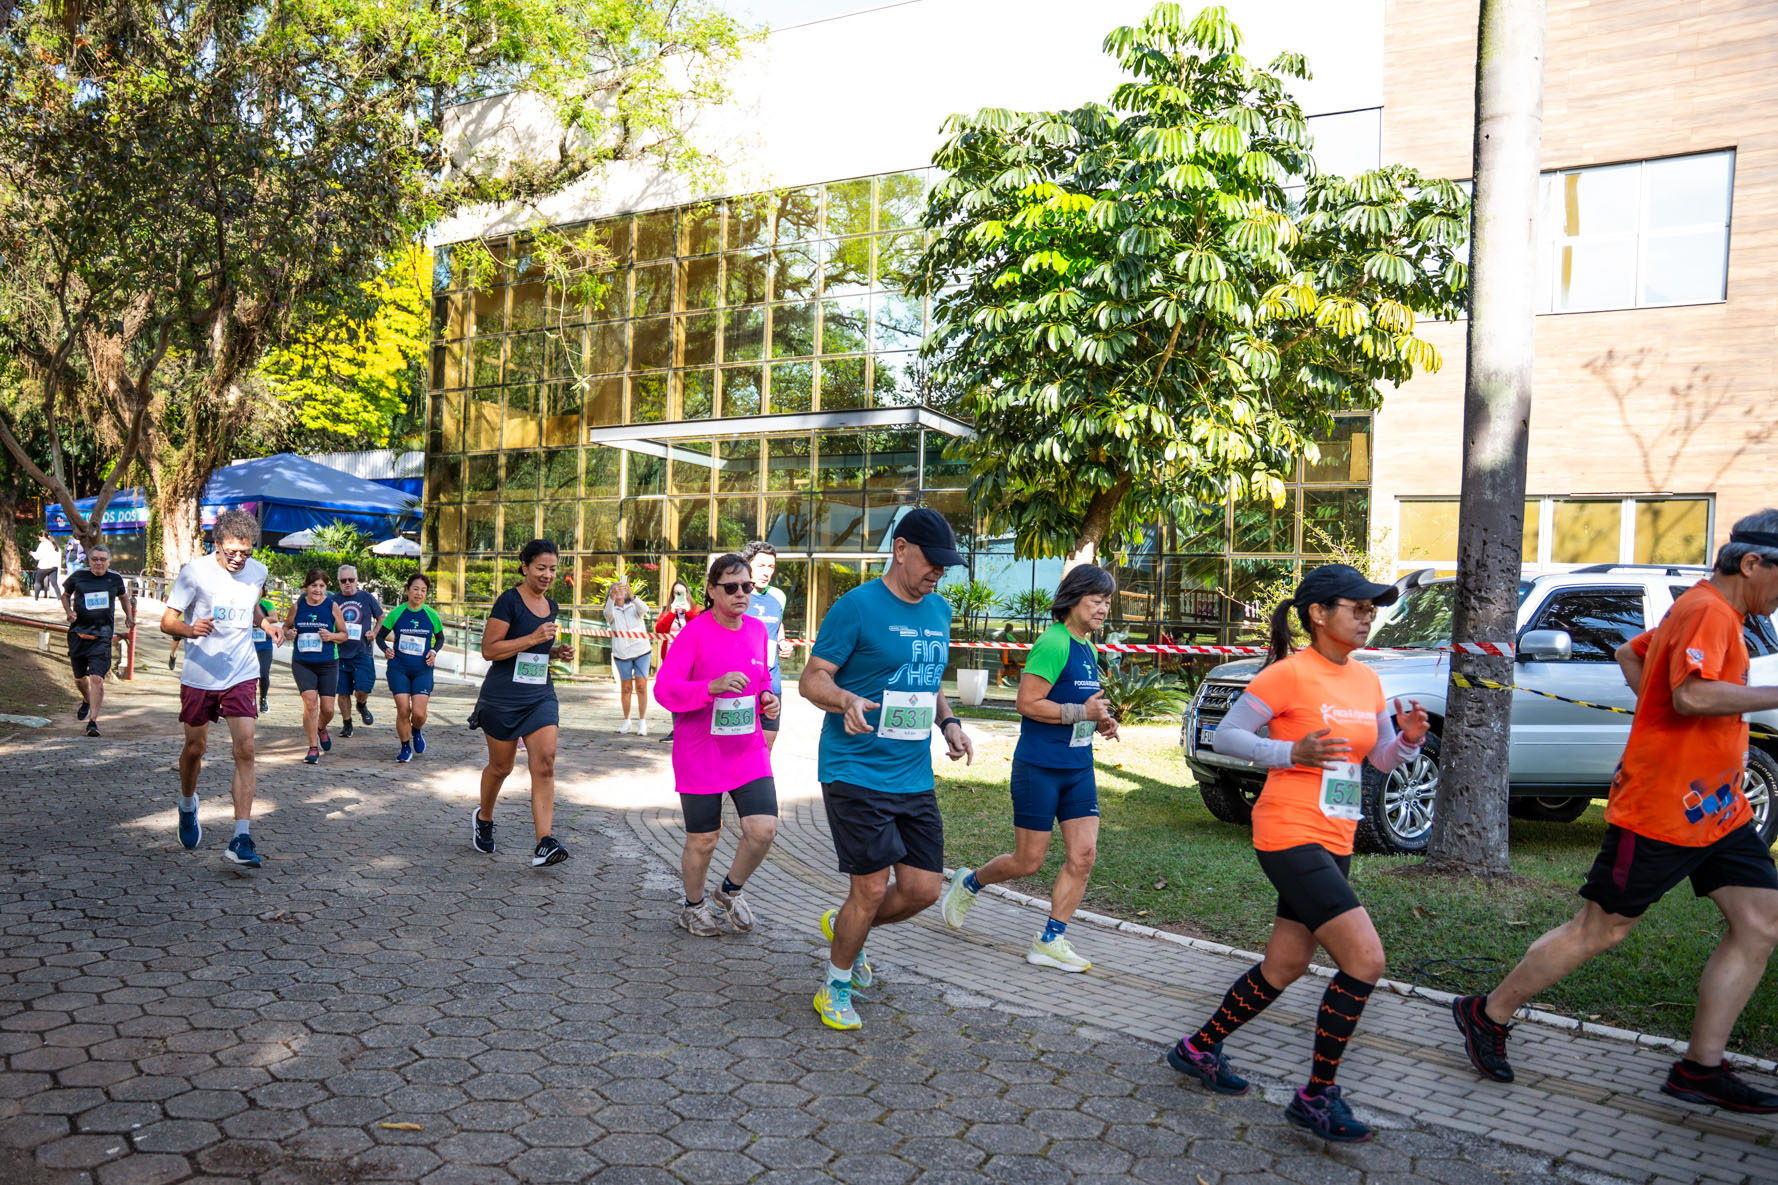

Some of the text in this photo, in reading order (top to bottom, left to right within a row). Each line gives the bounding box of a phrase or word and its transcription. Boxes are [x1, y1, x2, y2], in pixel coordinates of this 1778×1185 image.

[118, 511, 137, 522] DOS
[217, 608, 246, 621] 307
[521, 664, 545, 677] 535
[720, 710, 751, 726] 536
[890, 709, 927, 729] 531
